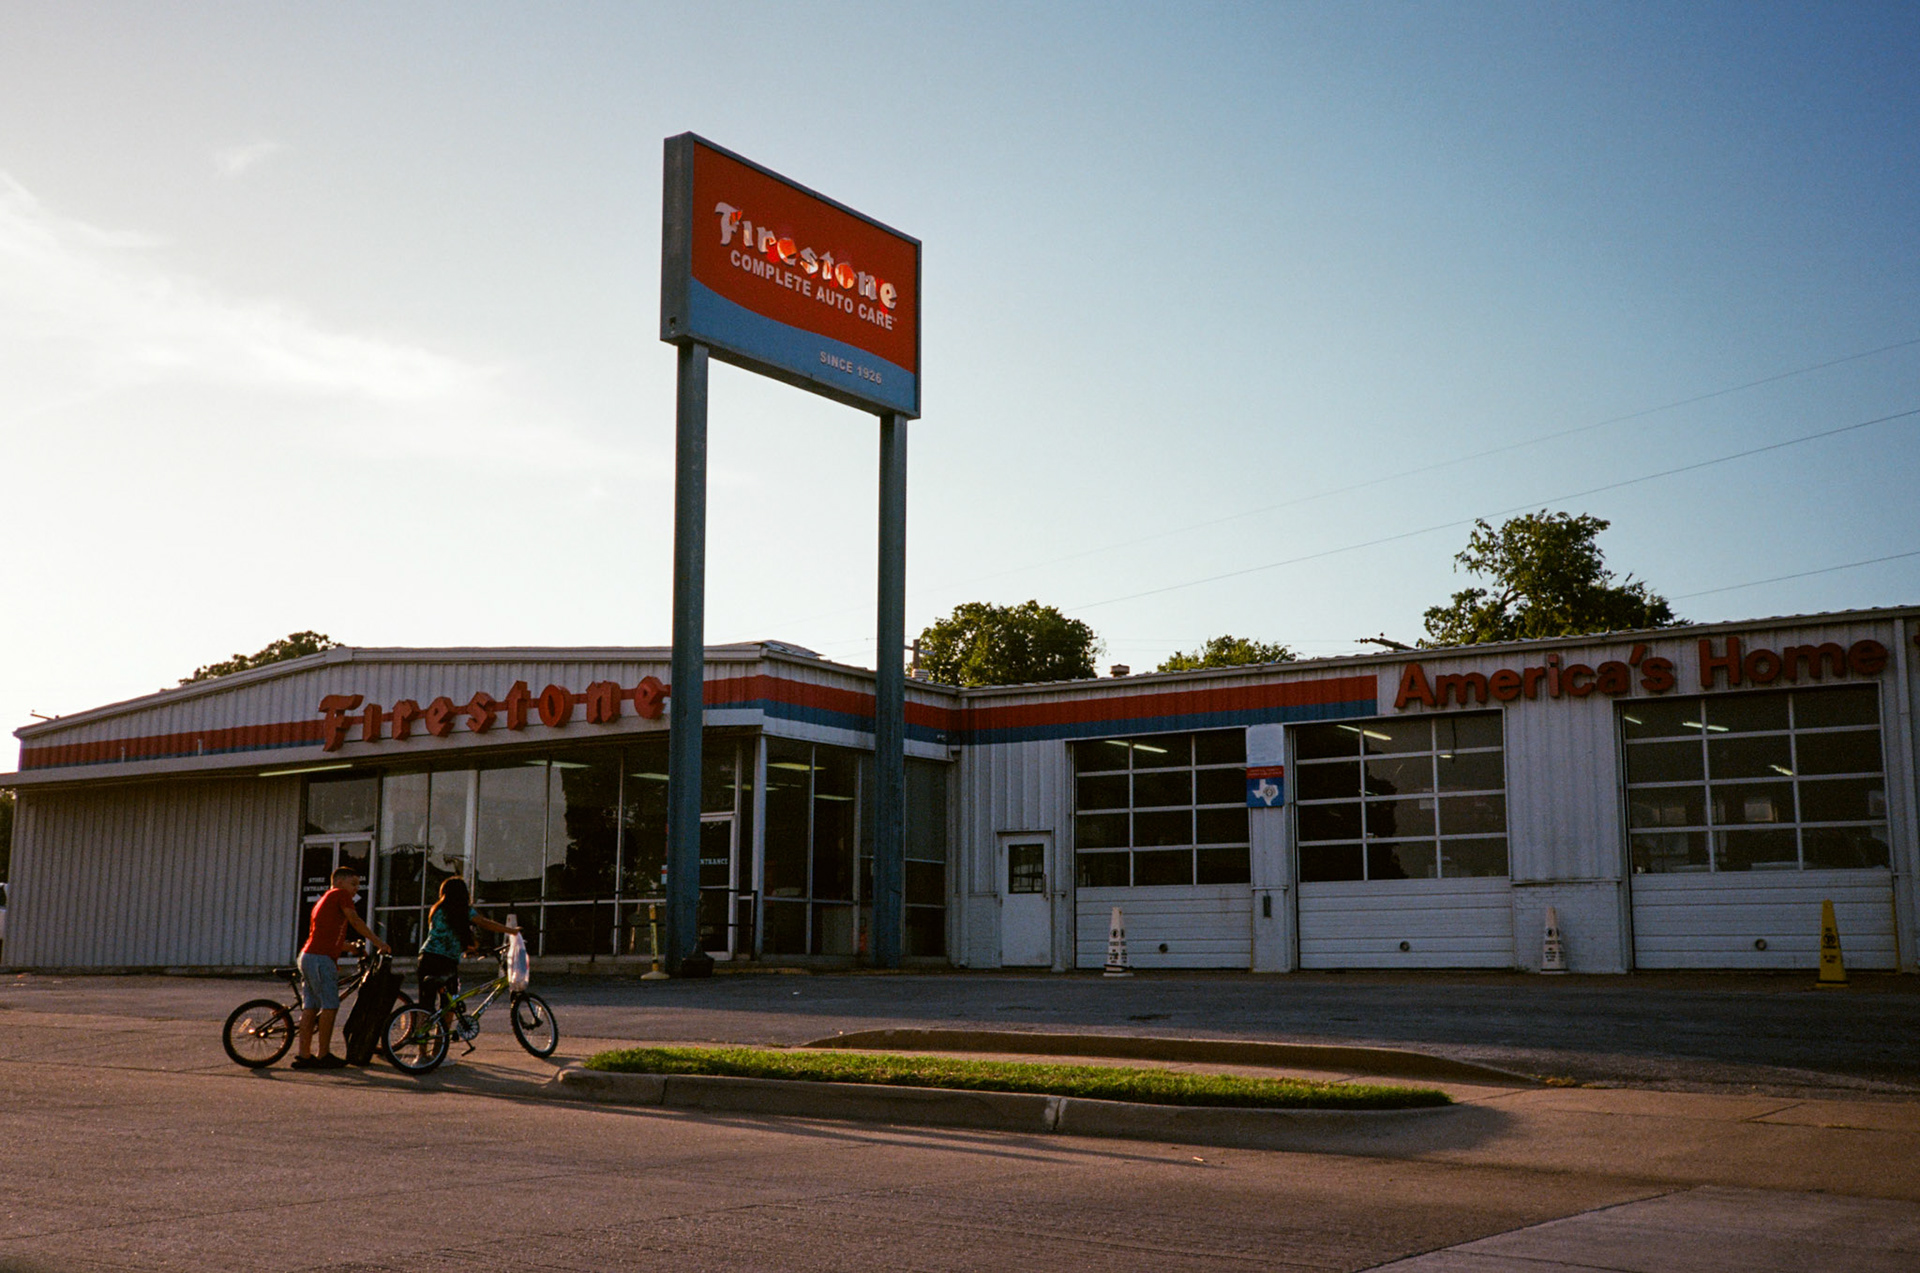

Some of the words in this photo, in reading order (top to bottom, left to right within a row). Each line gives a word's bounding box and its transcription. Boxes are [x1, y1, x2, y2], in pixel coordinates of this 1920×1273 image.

[715, 202, 897, 309] Firestone
[730, 250, 811, 297] COMPLETE
[816, 286, 853, 314] AUTO
[858, 303, 893, 330] CARE
[820, 351, 853, 374] SINCE
[857, 365, 882, 384] 1926
[1394, 644, 1675, 708] America's
[1699, 636, 1889, 689] Home
[318, 675, 666, 752] Firestone
